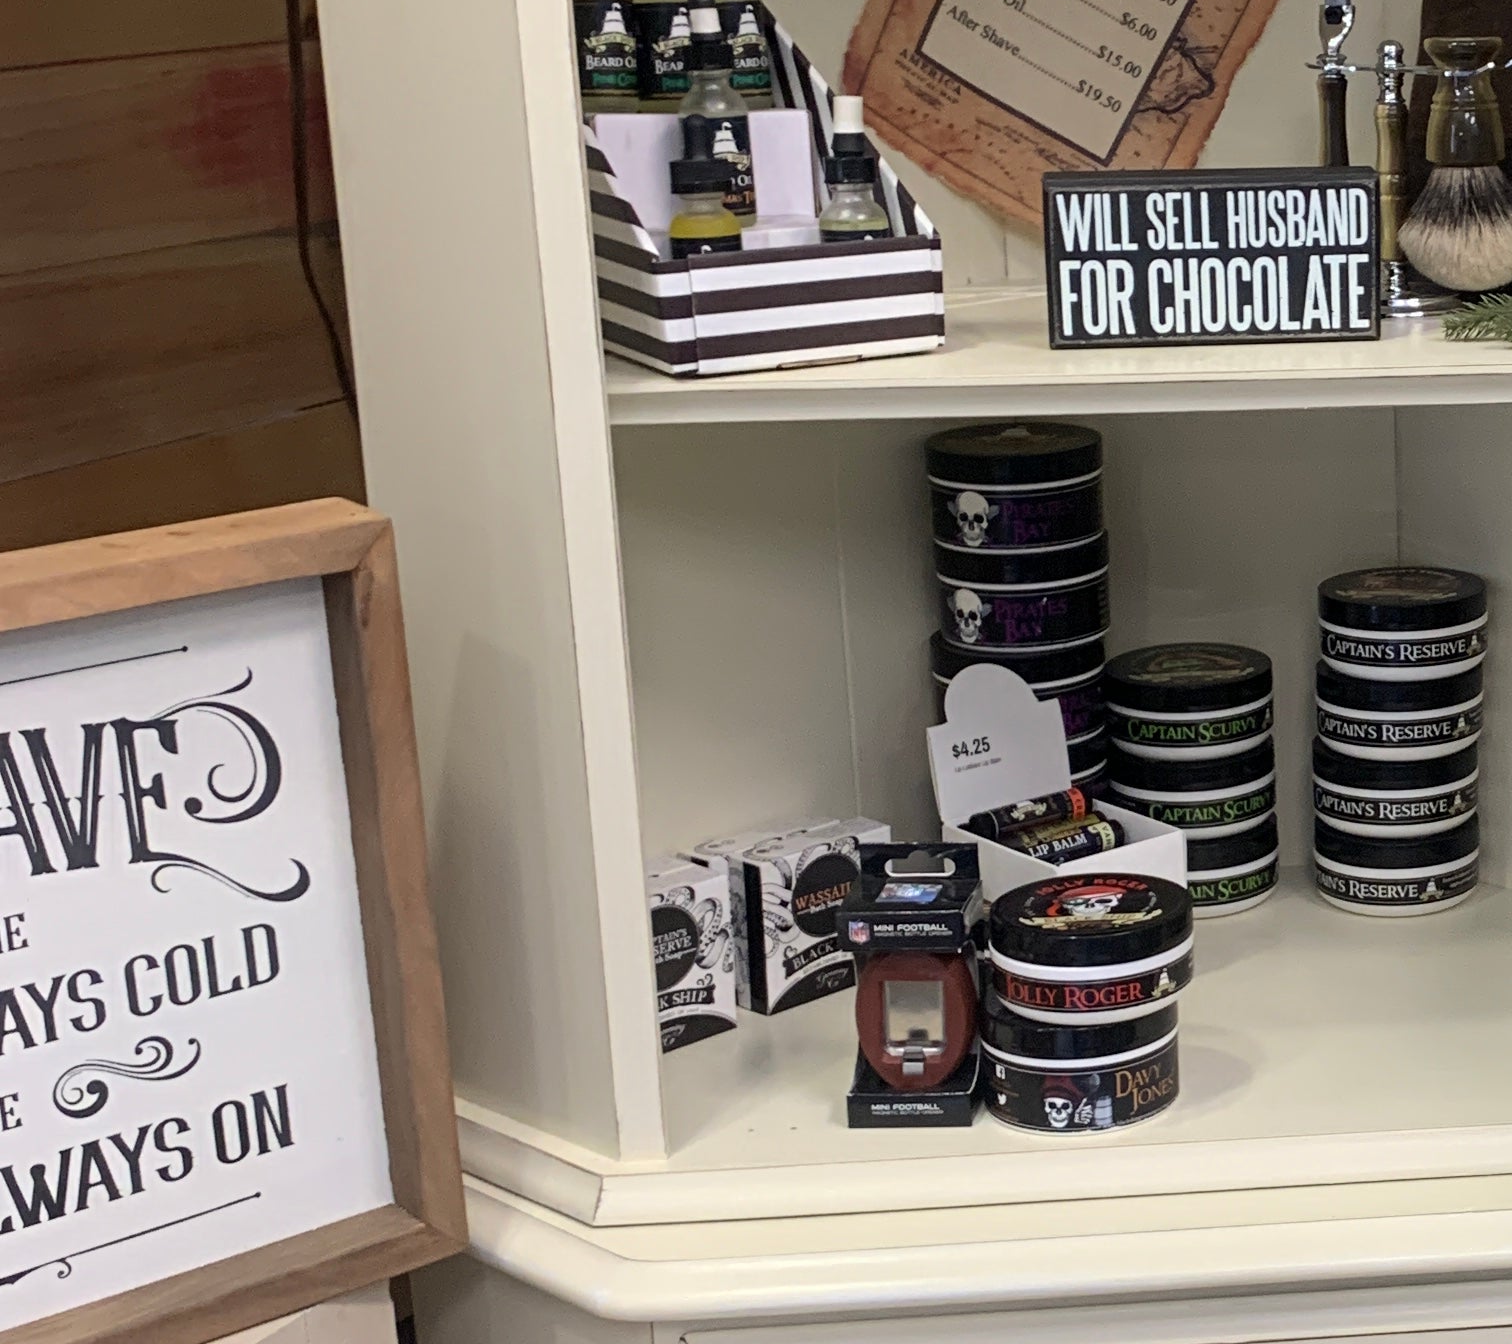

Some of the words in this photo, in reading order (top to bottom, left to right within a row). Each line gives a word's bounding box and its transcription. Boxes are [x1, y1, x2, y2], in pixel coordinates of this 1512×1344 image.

[1118, 11, 1158, 43] $6.00
[585, 55, 624, 71] BEARD
[625, 56, 637, 68] OI
[655, 59, 684, 75] BEAR
[899, 47, 963, 97] AMERICA
[946, 4, 980, 32] After
[1075, 78, 1123, 113] $19.50
[1096, 44, 1142, 80] $15.00
[1055, 193, 1139, 252] WILL
[1145, 191, 1219, 251] SELL
[1226, 187, 1369, 250] HUSBAND
[1058, 258, 1137, 337] FOR
[1147, 253, 1371, 335] CHOCOLATE
[1327, 633, 1395, 660] CAPTAIN'S
[1399, 639, 1467, 662] RESERVE
[1128, 719, 1195, 742] CAPTAIN
[1197, 716, 1257, 745] SCURVY
[1318, 711, 1377, 740] CAPTAIN'S
[1381, 720, 1451, 743] RESERVE
[951, 736, 991, 760] $4.25
[1149, 804, 1222, 823] CAPTAIN
[1223, 791, 1272, 823] SCURVY
[1315, 787, 1375, 817] CAPTAIN'S
[1378, 798, 1448, 821] RESERVE
[1028, 843, 1049, 858] LIP
[1053, 833, 1088, 852] BALM
[1035, 878, 1085, 896] JOLLY
[1093, 877, 1149, 891] ROGER
[1217, 871, 1271, 901] SCURVY
[1349, 879, 1419, 899] RESERVE
[653, 927, 688, 943] PTAIN'S
[873, 923, 894, 932] MINI
[896, 923, 948, 932] FOOTBALL
[653, 936, 692, 955] SERVE
[792, 939, 834, 970] BLACK
[0, 967, 108, 1056] AYS
[123, 923, 281, 1017] COLD
[672, 989, 707, 1005] SHIP
[1005, 972, 1058, 1005] JOLLY
[1063, 982, 1145, 1012] ROGER
[1115, 1062, 1162, 1098] DAVY
[870, 1103, 891, 1111] MINI
[892, 1103, 940, 1111] FOOTBALL
[1130, 1076, 1175, 1116] JONES
[212, 1083, 295, 1164] ON
